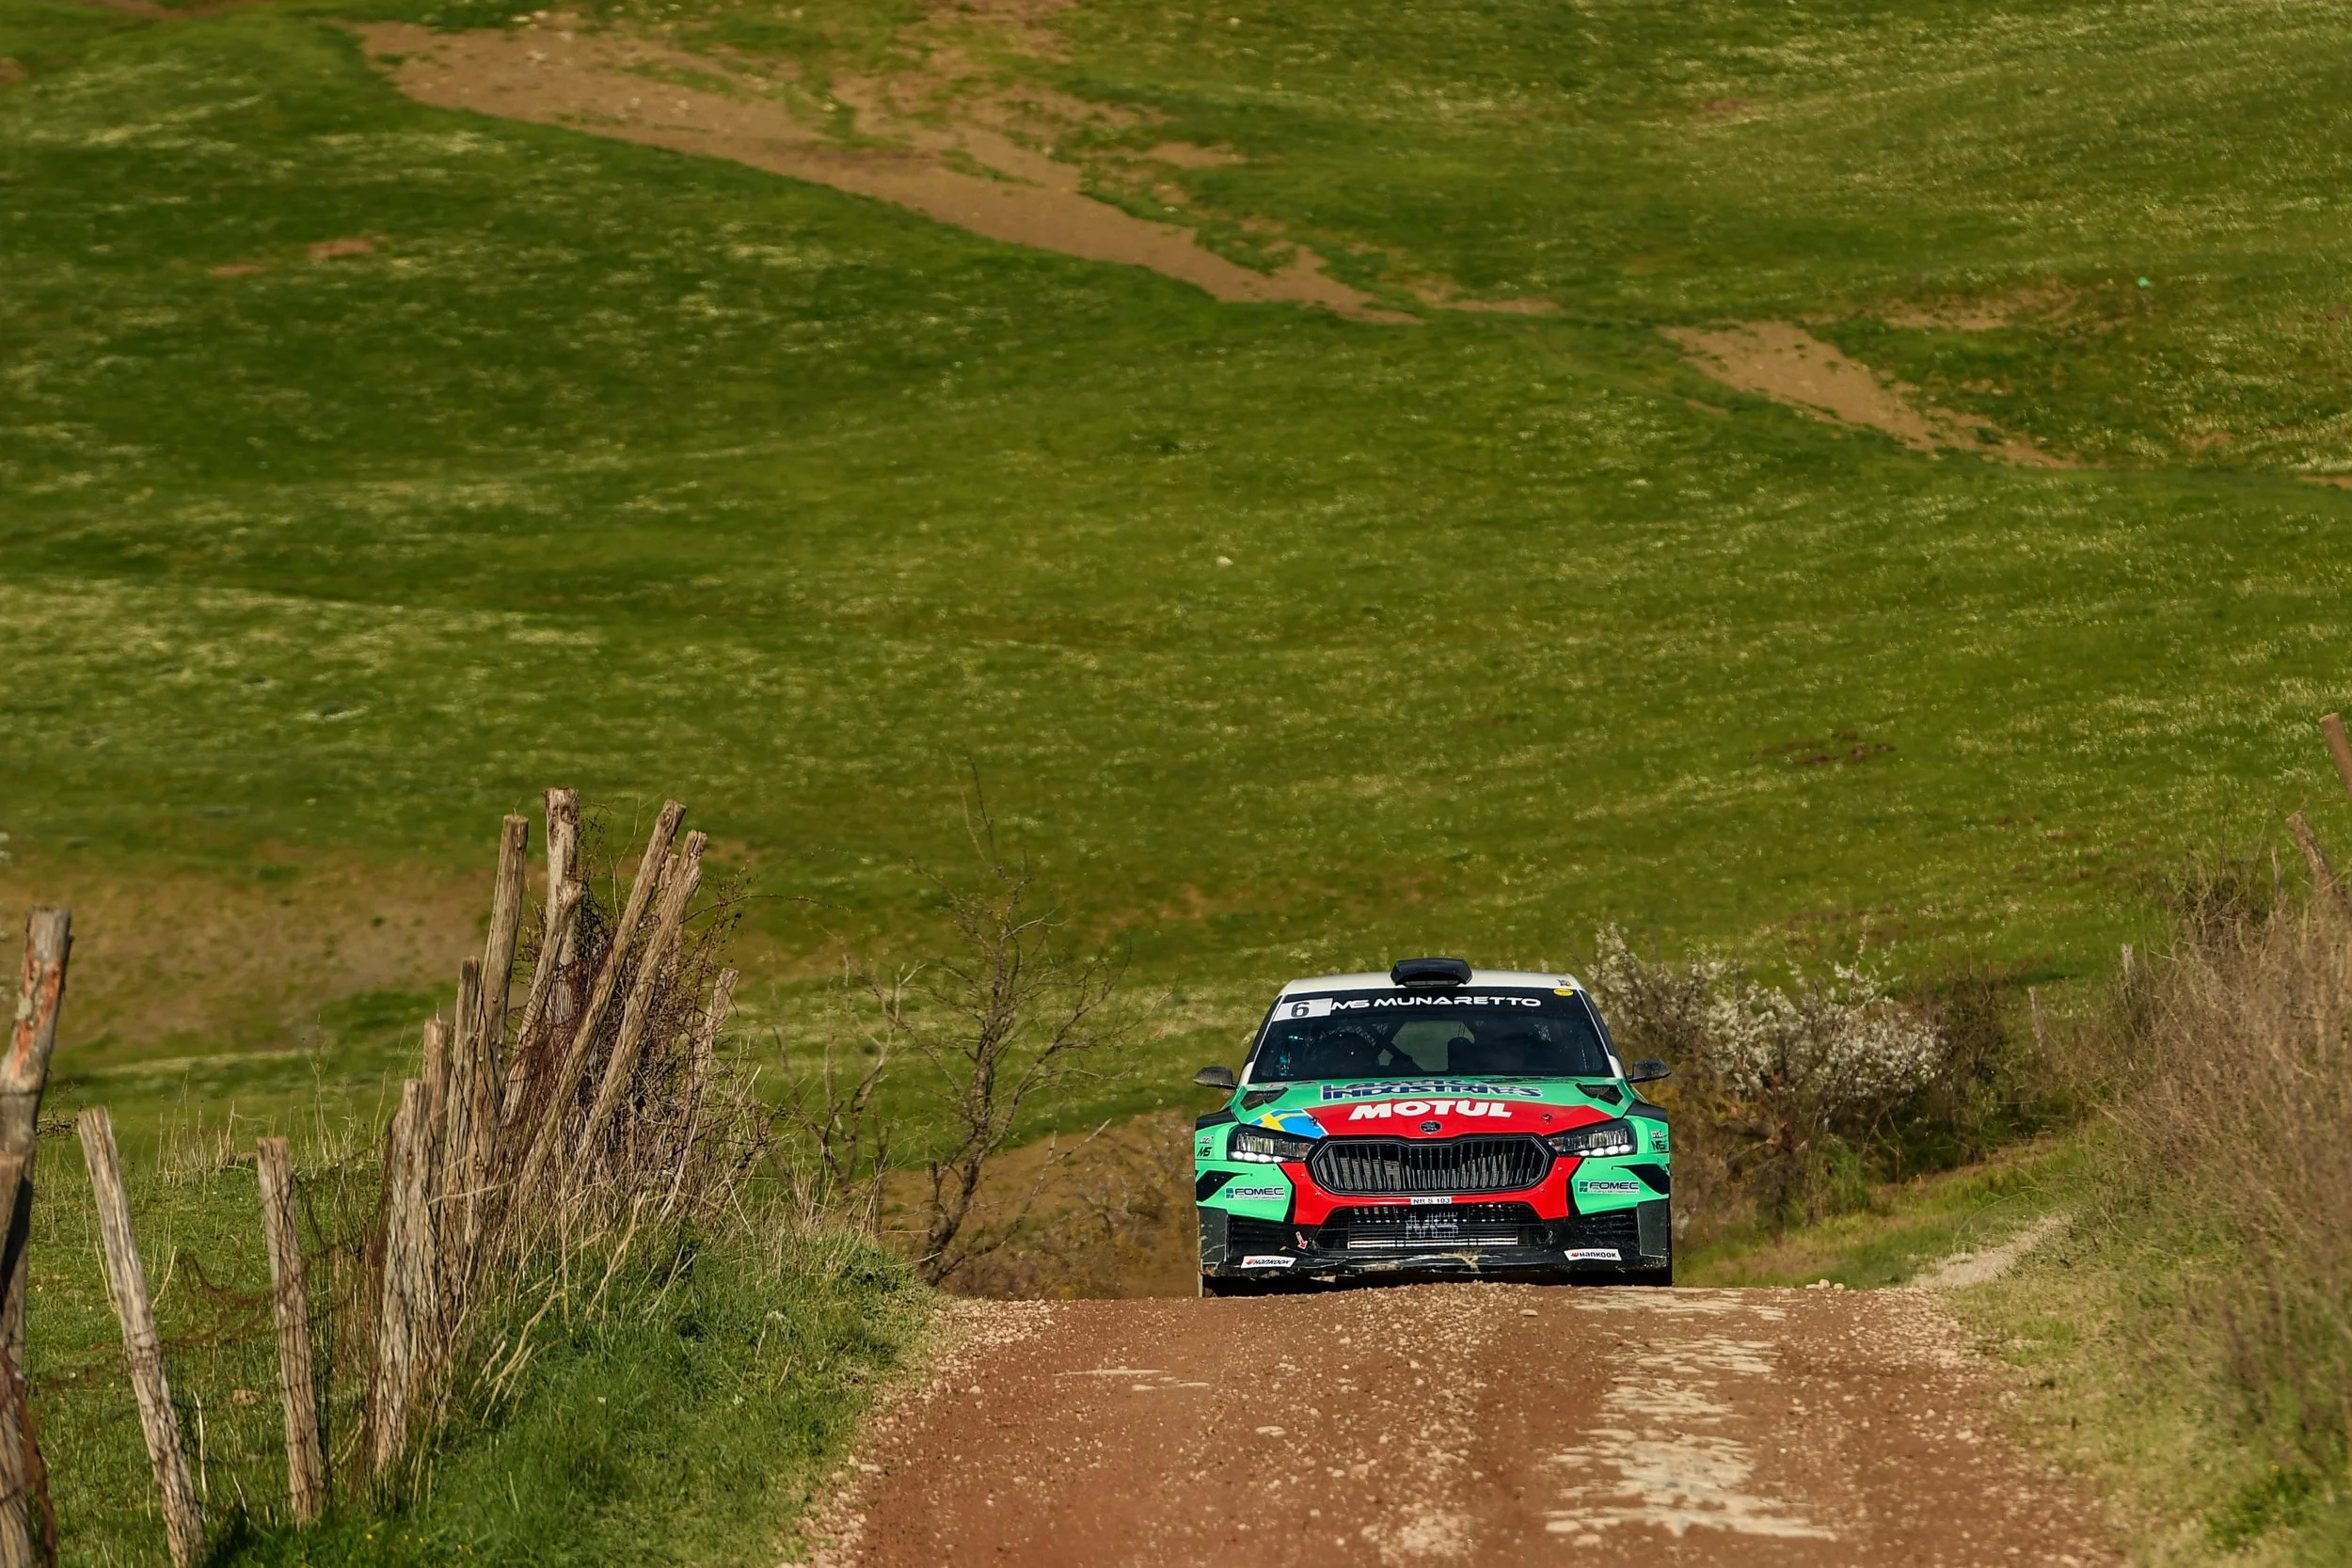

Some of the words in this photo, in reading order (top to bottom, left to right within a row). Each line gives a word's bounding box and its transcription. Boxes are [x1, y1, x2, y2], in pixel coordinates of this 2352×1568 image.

[1291, 1002, 1311, 1018] 6
[1330, 999, 1371, 1011] MS
[1373, 995, 1542, 1007] MUNARETTO
[1348, 1100, 1513, 1120] MOTUL
[1235, 1187, 1284, 1196] FOMEC
[1589, 1181, 1640, 1190] FOMEC
